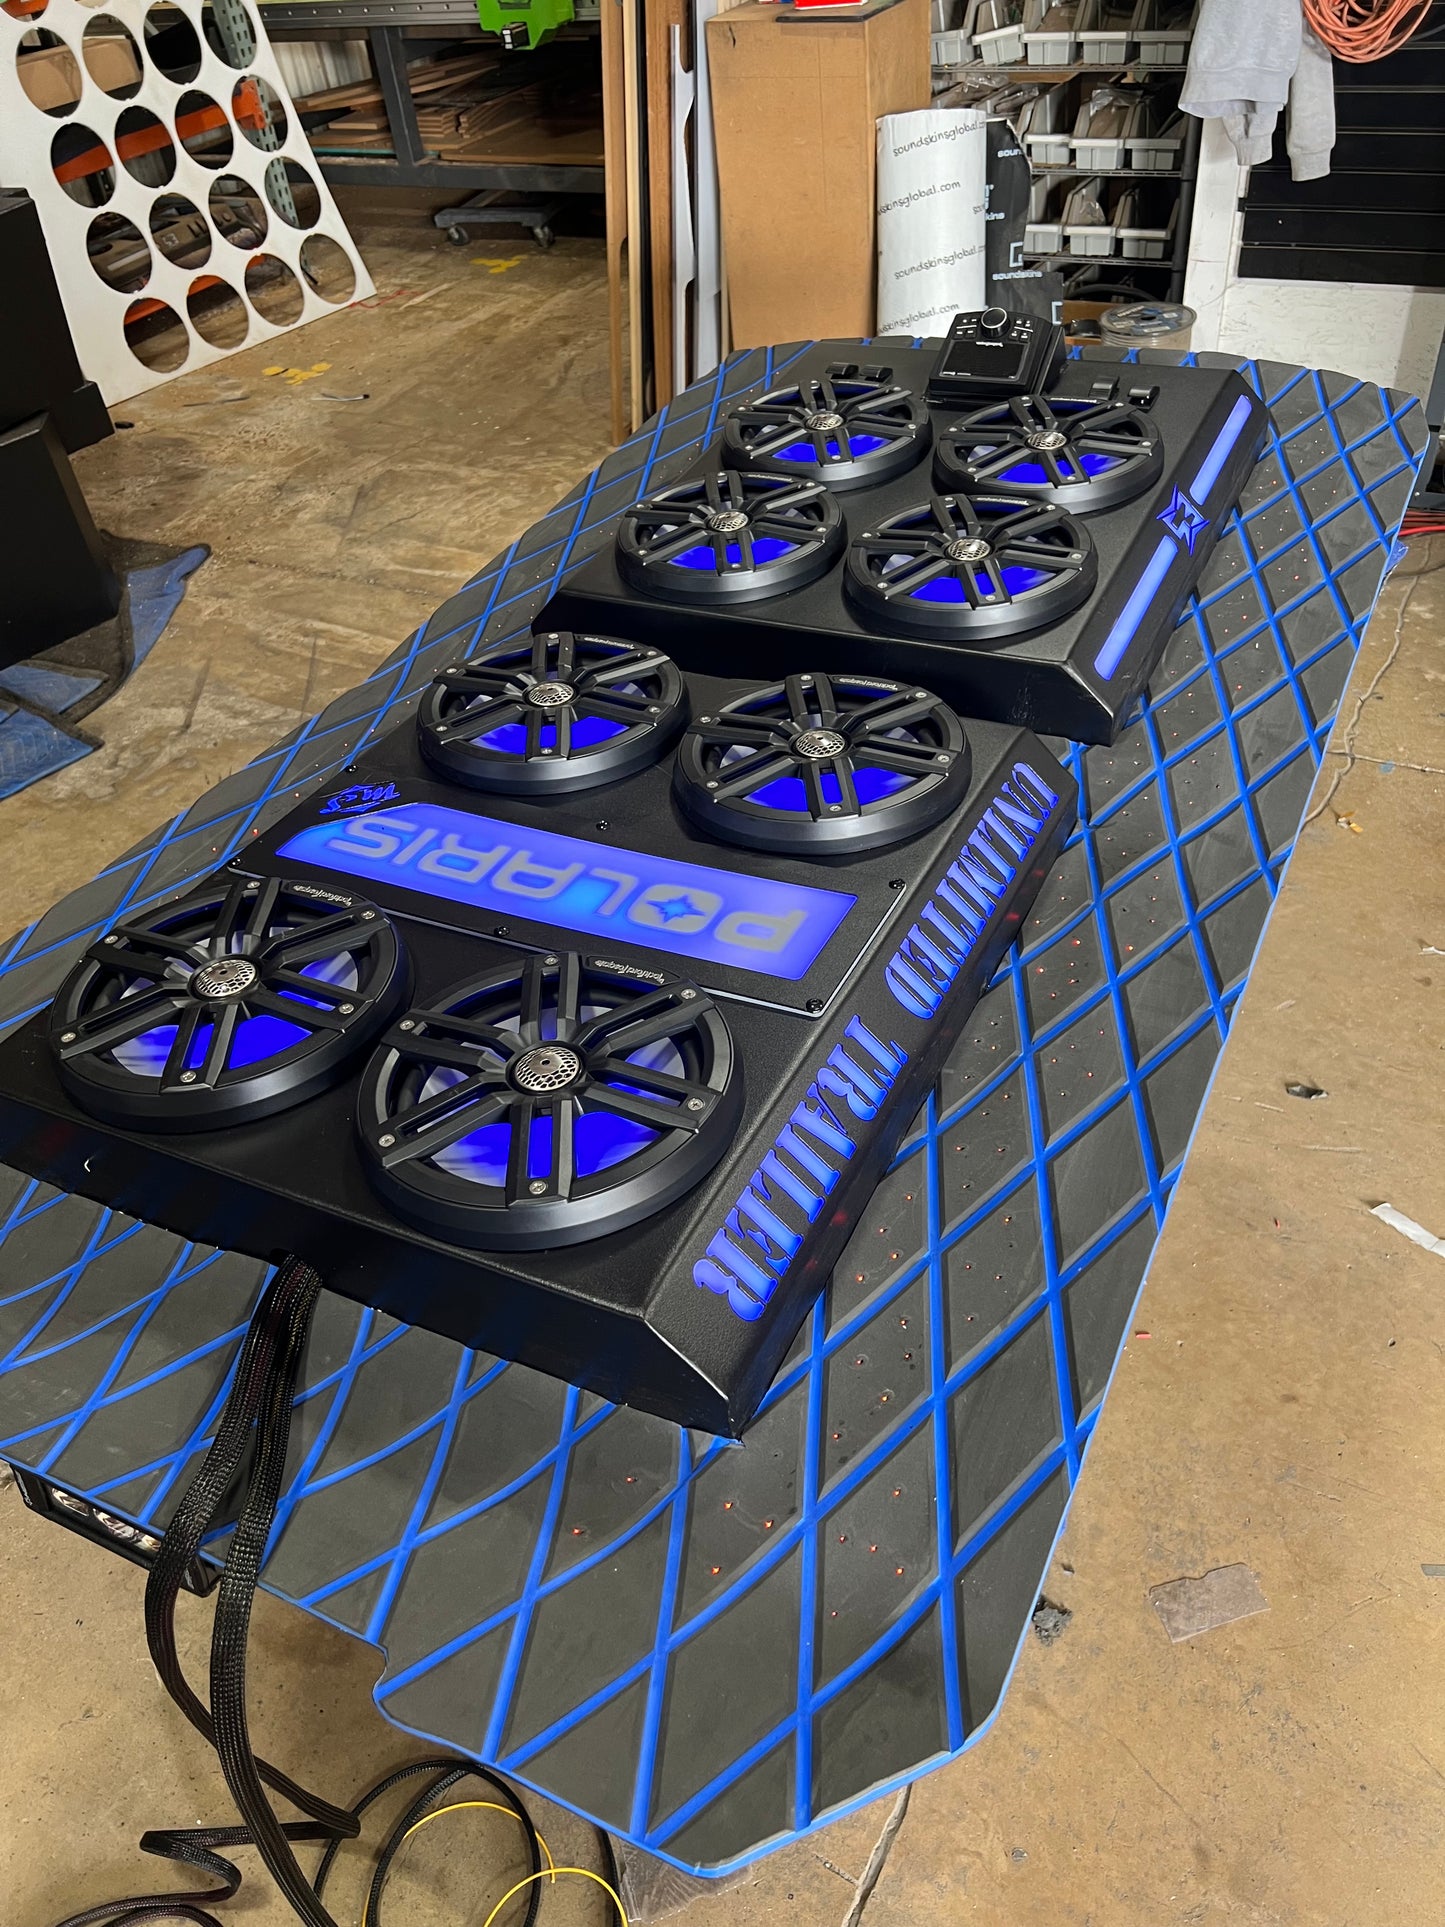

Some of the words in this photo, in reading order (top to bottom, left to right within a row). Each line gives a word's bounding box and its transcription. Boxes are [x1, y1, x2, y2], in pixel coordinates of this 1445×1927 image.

[326, 815, 810, 953] POLARIS
[883, 761, 1060, 1021] UNLIMITED
[692, 1013, 909, 1322] TRAILER
